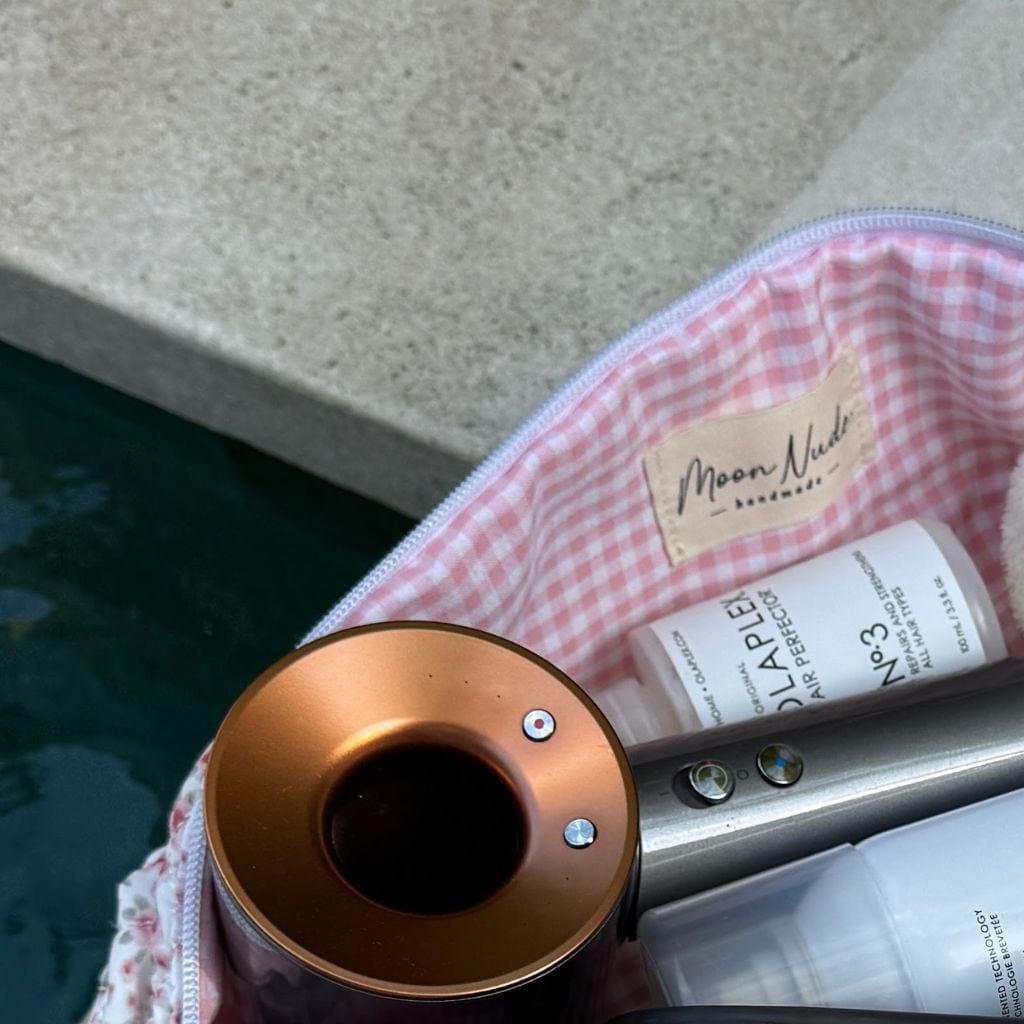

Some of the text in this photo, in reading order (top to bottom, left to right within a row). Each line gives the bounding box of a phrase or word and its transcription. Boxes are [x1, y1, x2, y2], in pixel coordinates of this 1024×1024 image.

[677, 457, 778, 516] Moon
[884, 601, 902, 627] AND
[891, 586, 934, 670] ALL HAIR TYPES
[896, 629, 920, 676] REPAIRS
[704, 694, 725, 727] HOME
[737, 661, 765, 715] ORIGINAL
[800, 670, 826, 699] AIR
[973, 909, 1011, 1018] ENTED TECHNOLOGY
[1004, 960, 1023, 1018] CHNOLOGIE
